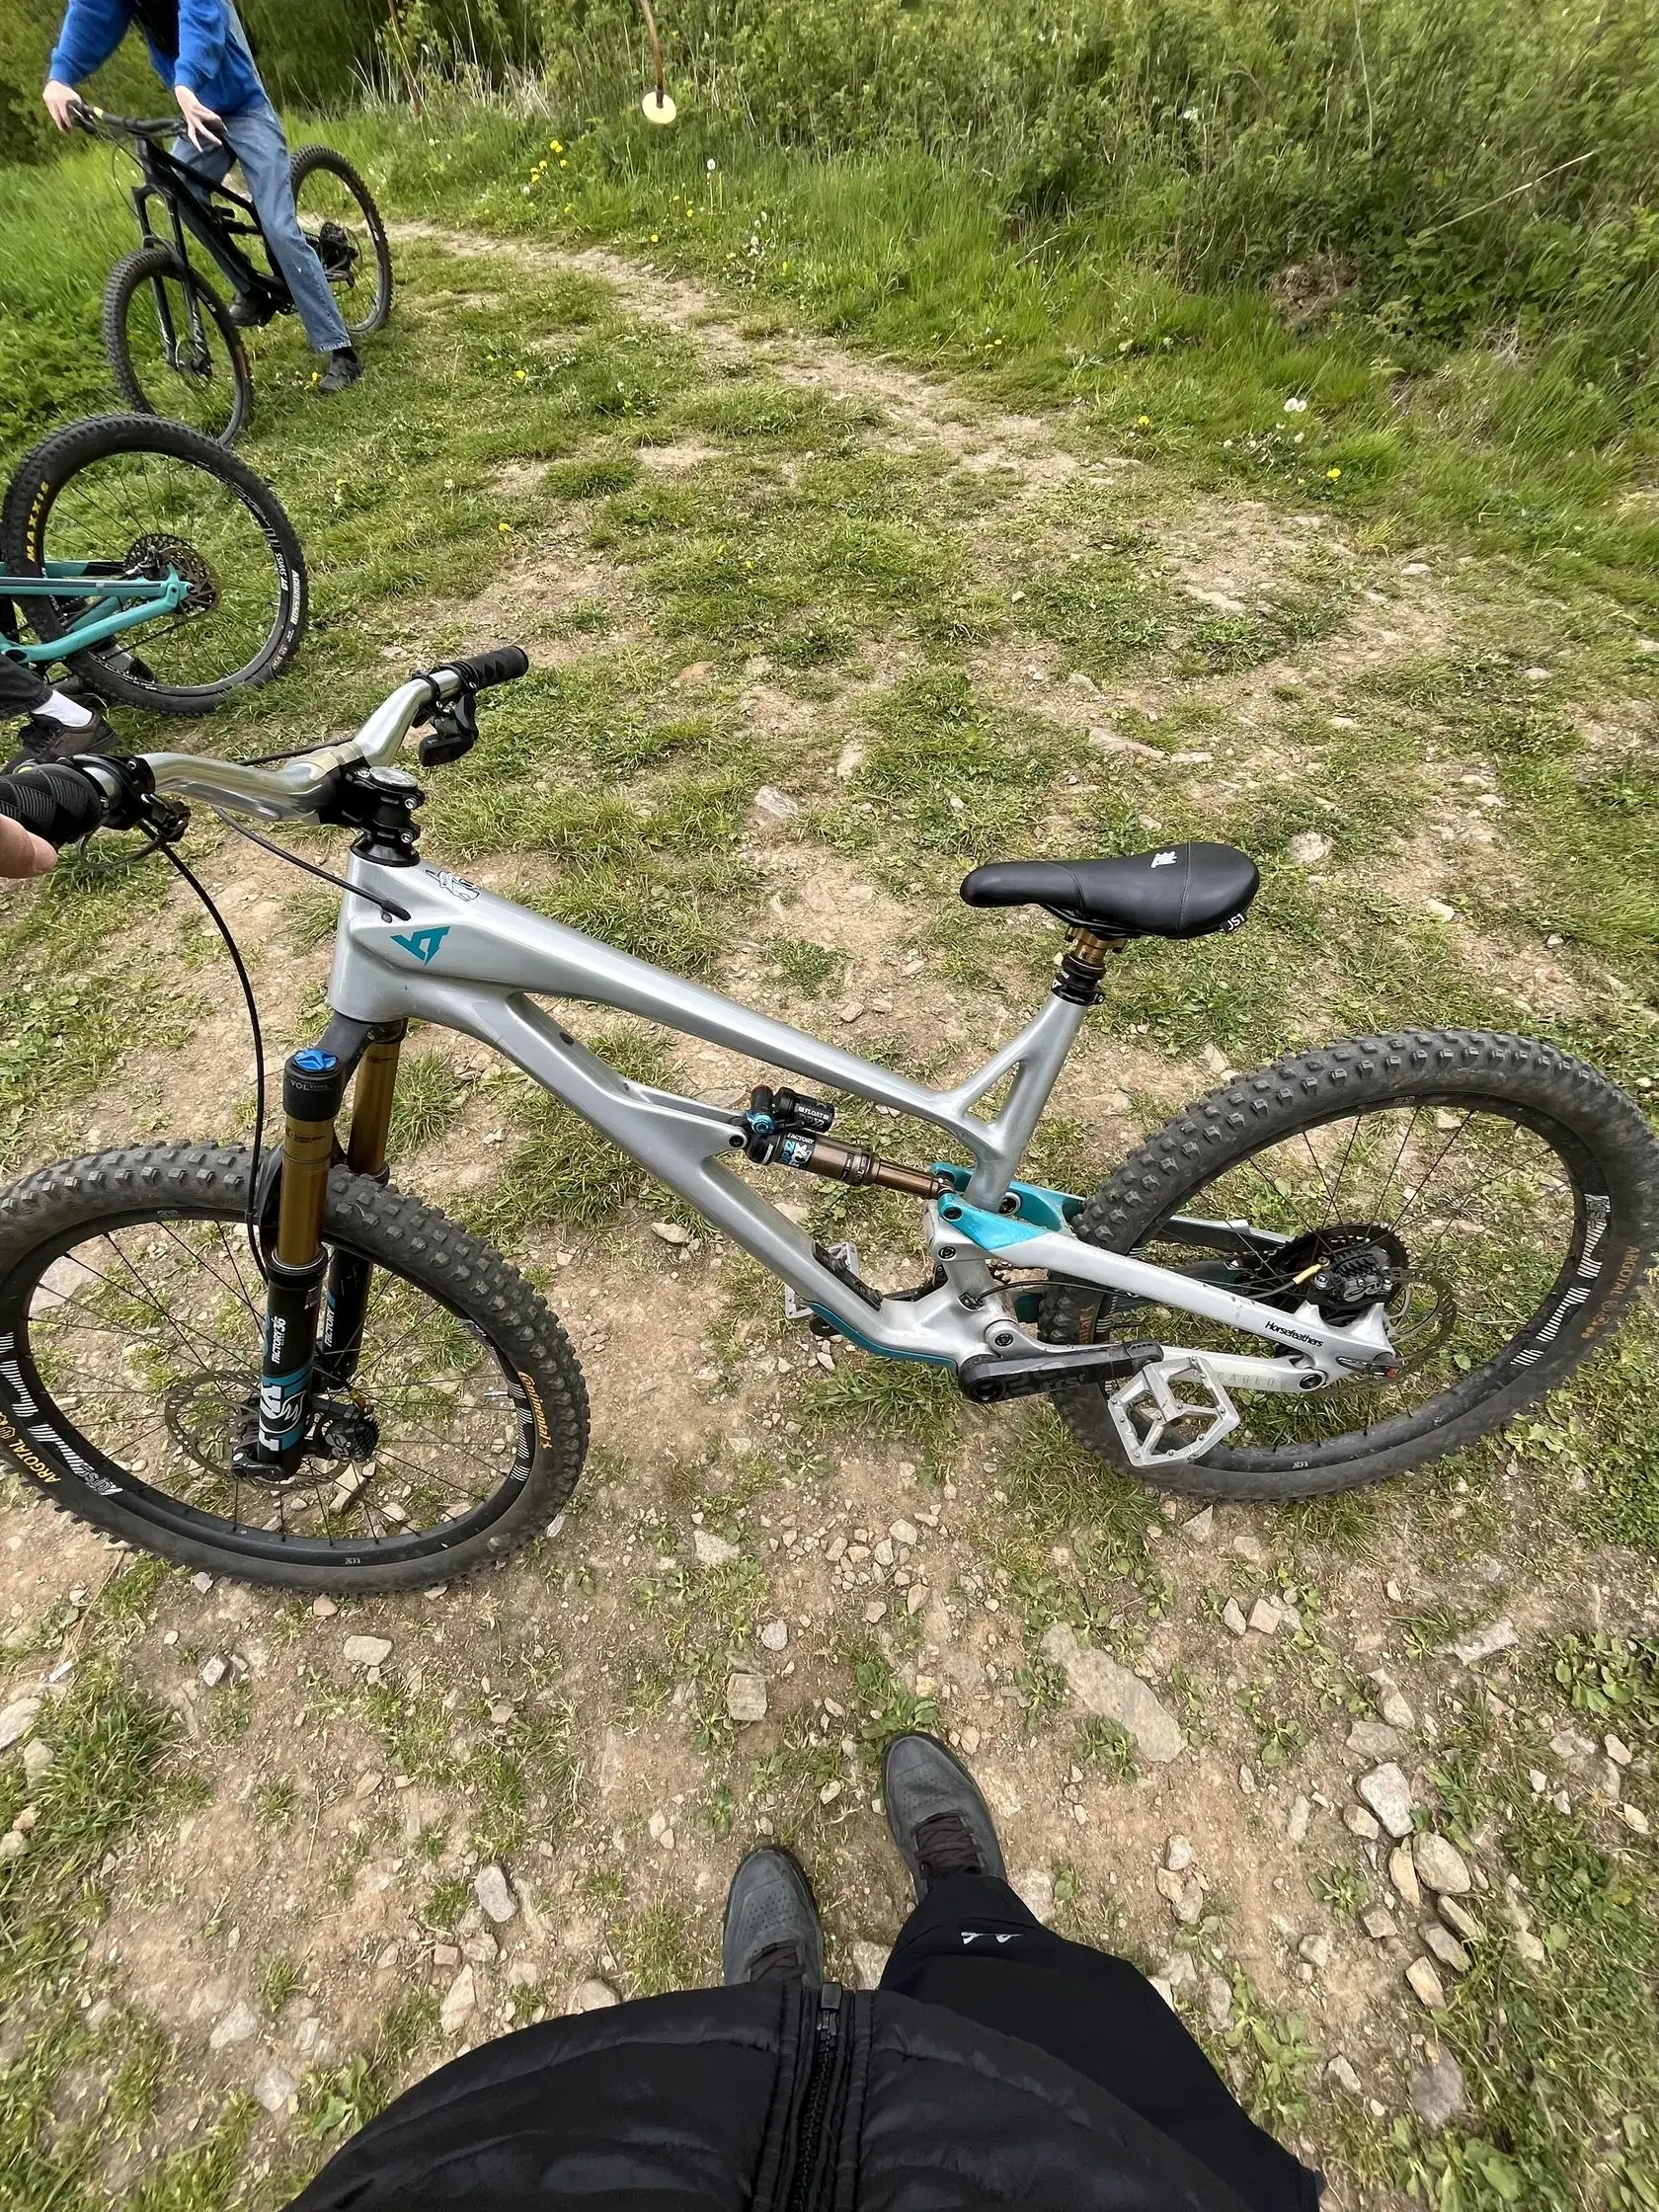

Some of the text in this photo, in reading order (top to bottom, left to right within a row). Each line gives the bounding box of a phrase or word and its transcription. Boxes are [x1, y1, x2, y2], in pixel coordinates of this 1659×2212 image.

[1226, 912, 1245, 931] JS1
[804, 1107, 824, 1120] FLOAT
[787, 1132, 816, 1145] FACTORY
[1610, 1245, 1640, 1296] ARGOTAL
[325, 1305, 335, 1347] FACTORY
[1265, 1319, 1324, 1348] Horsefeathers
[271, 1331, 284, 1364] FACTORY
[518, 1371, 549, 1446] Continental
[9, 1438, 61, 1483] ARGOTAL
